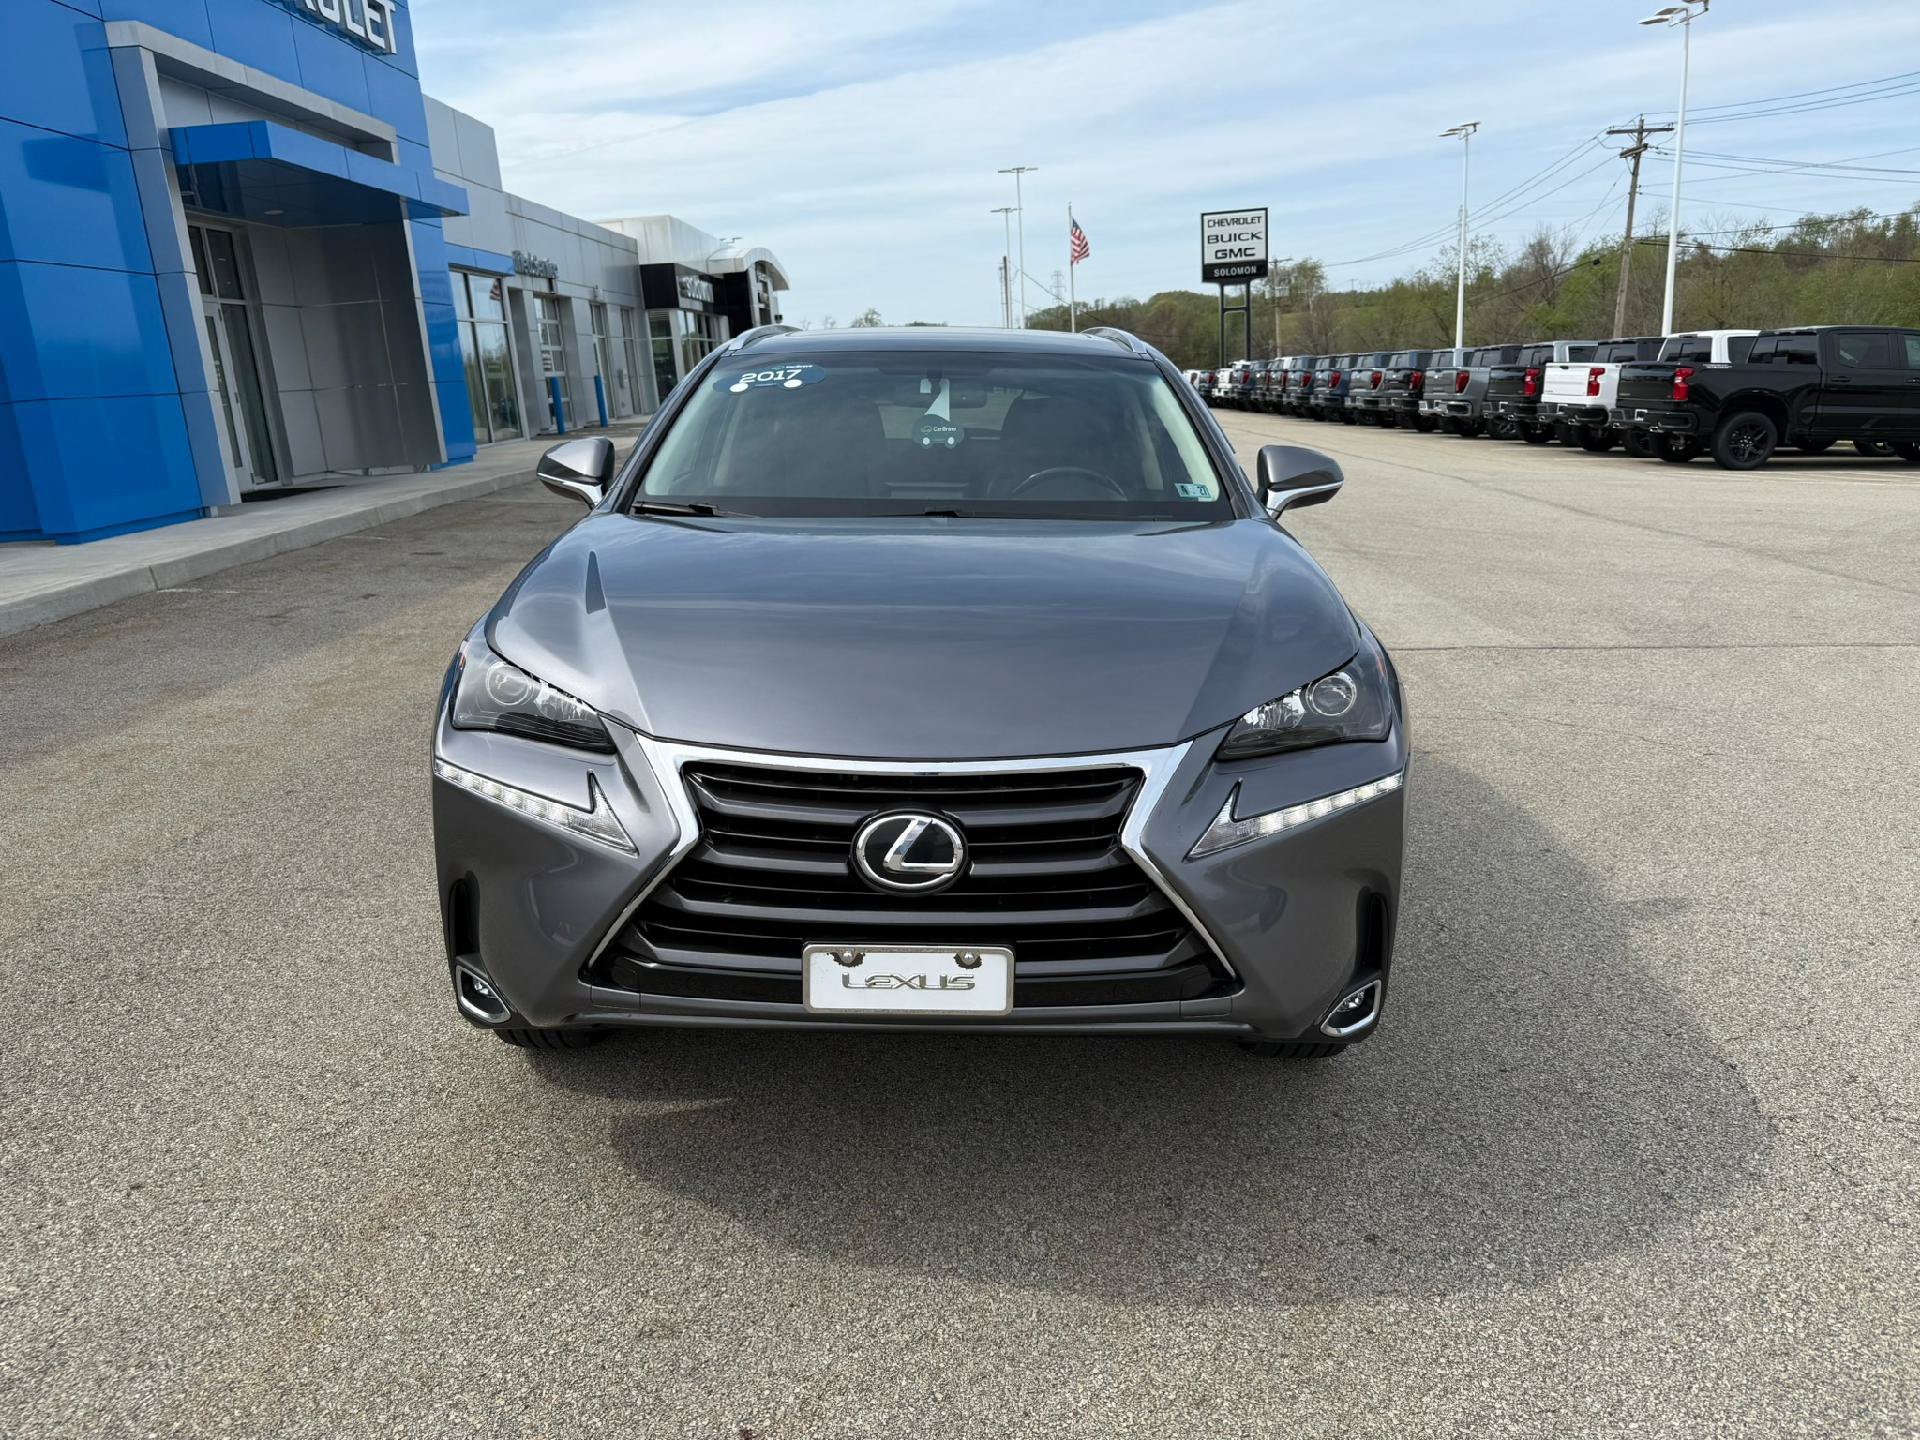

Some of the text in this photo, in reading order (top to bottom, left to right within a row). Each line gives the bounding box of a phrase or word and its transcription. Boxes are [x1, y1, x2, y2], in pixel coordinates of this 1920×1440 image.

[304, 0, 398, 54] LET
[1207, 215, 1262, 228] CHEVROLET
[1207, 231, 1263, 244] BUICK
[1214, 247, 1256, 260] GMC
[1213, 265, 1257, 277] SOLOMON
[738, 369, 802, 384] 2017
[842, 972, 976, 991] LEXUS
